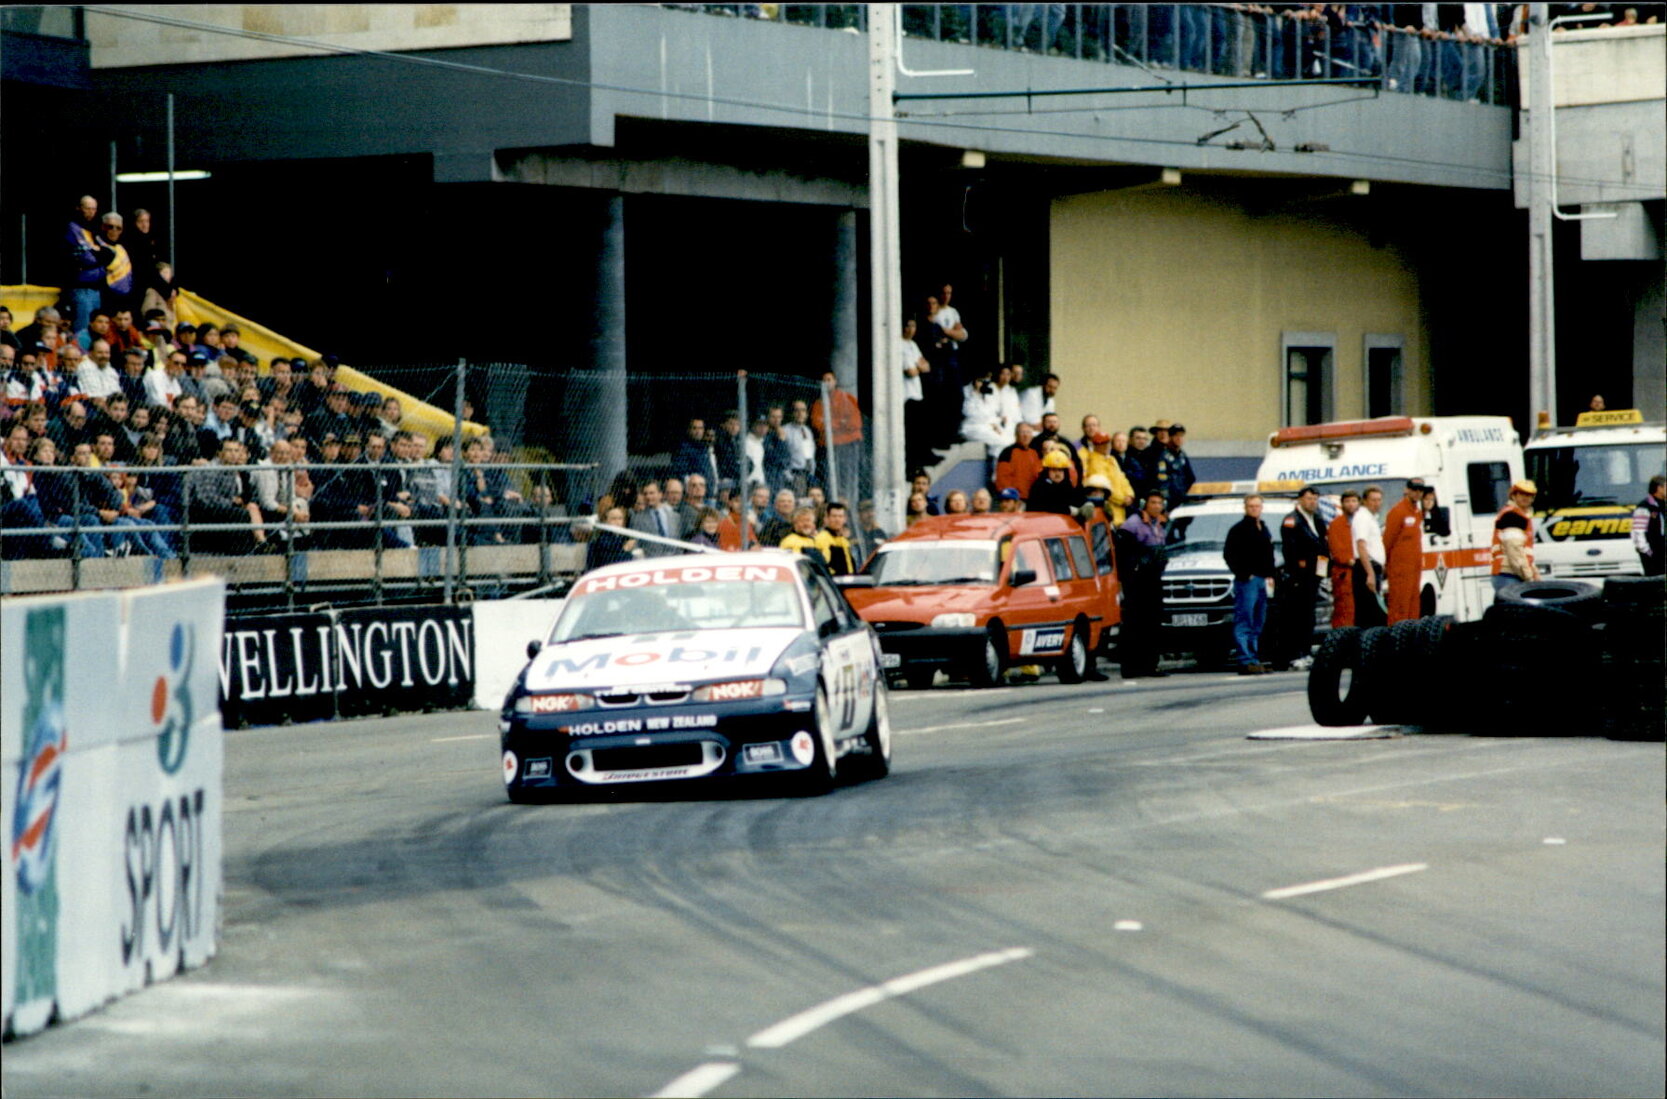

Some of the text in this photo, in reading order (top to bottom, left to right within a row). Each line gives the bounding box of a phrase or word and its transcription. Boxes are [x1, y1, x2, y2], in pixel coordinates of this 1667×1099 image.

[1592, 412, 1635, 425] SERVICE
[1277, 463, 1388, 482] AMBULANCE
[586, 566, 778, 593] HOLDEN
[1036, 634, 1065, 648] AVERY
[545, 648, 763, 678] Mobil
[713, 681, 755, 700] NGK
[532, 694, 571, 711] NGK
[569, 714, 718, 737] HOLDEN NEW ZEALAND
[120, 787, 205, 967] SPORT
